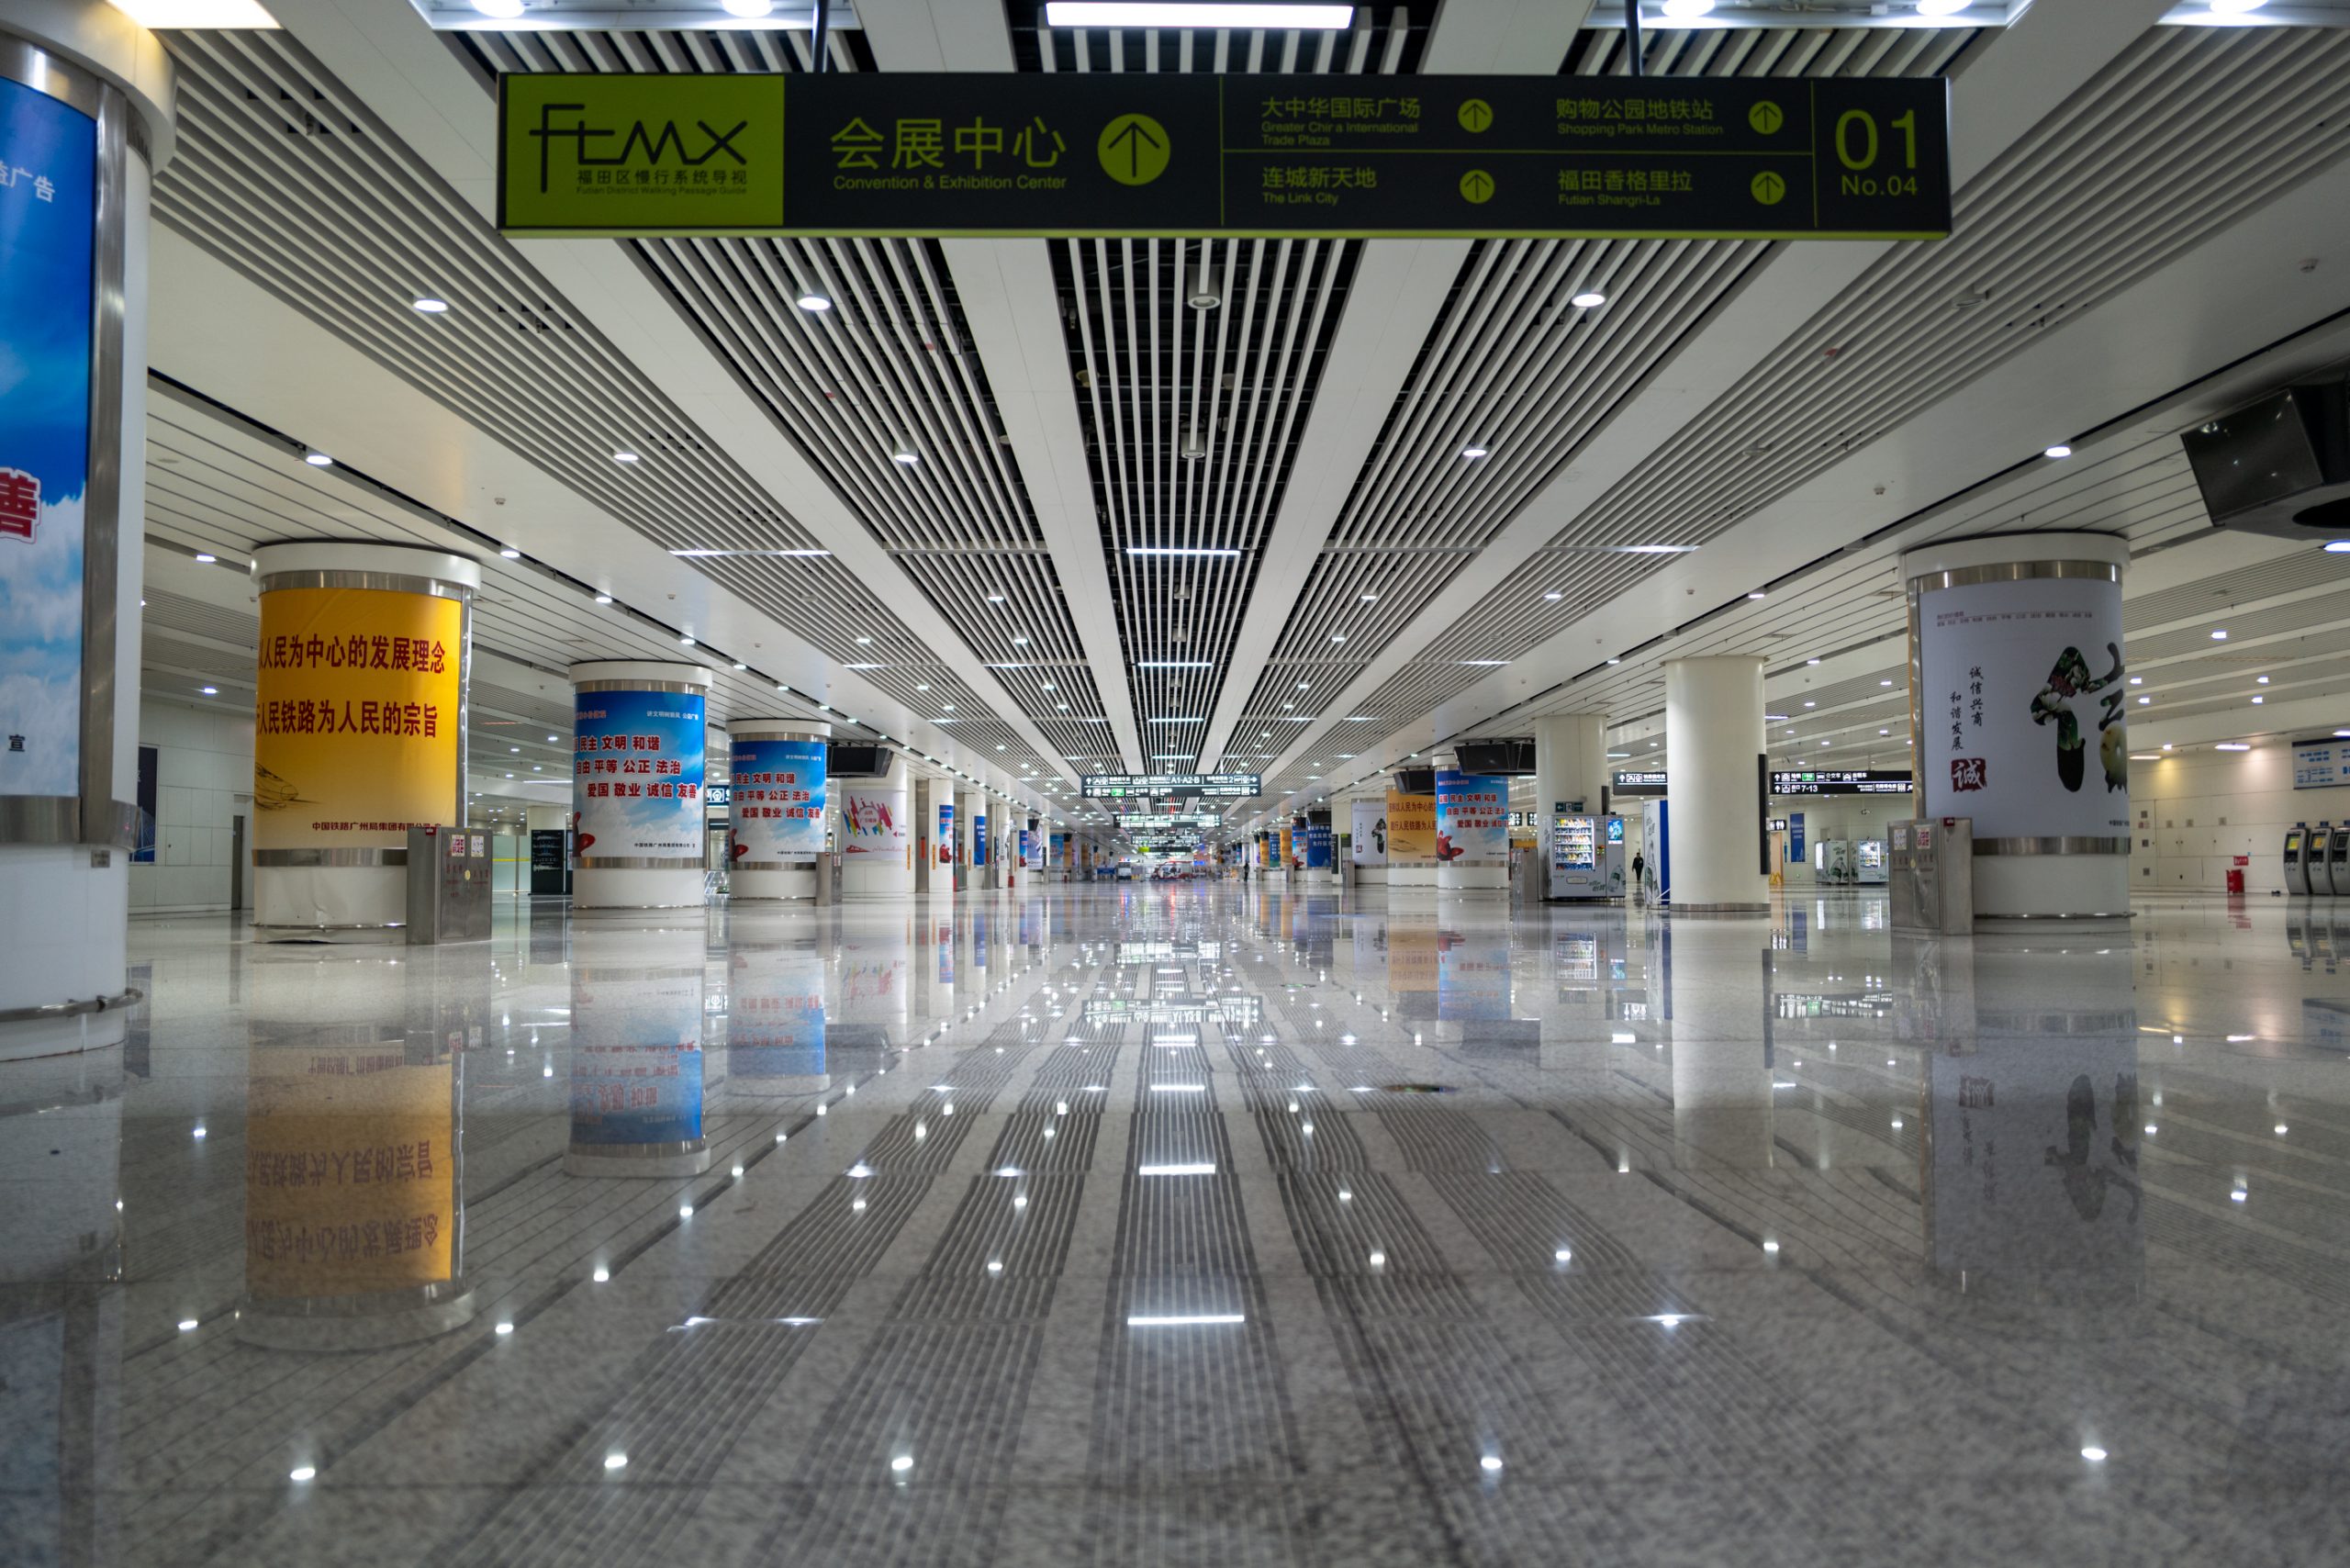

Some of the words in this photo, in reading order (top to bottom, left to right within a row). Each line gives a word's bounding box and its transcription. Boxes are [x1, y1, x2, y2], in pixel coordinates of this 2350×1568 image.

[1261, 96, 1421, 119] 大中华国际广场
[1556, 98, 1714, 120] 购物公园地铁站
[1261, 121, 1305, 133] Greater
[1346, 121, 1419, 133] International
[1557, 122, 1615, 137] Shopping
[1617, 123, 1643, 135] Park
[1646, 123, 1679, 135] Metro
[1682, 123, 1723, 136] Station
[830, 116, 1067, 170] 会展中心
[1262, 134, 1295, 146] Trade
[1298, 134, 1330, 146] Plaza
[1835, 108, 1916, 170] 01
[576, 169, 748, 185] 福田区慢行系统导视
[833, 175, 919, 190] Convention
[923, 175, 934, 189] &
[939, 175, 1013, 190] Exhibition
[1016, 175, 1067, 190] Center
[1262, 166, 1378, 189] 连城新天地
[1558, 169, 1694, 192] 福田香格里拉
[1841, 174, 1918, 196] No.04
[576, 186, 604, 196] Futian
[607, 186, 639, 196] District
[641, 186, 677, 196] Walking
[679, 186, 718, 196] Passage
[720, 186, 747, 196] Guide
[1263, 193, 1285, 204] The
[1288, 193, 1312, 204] Link
[1315, 193, 1339, 206] City
[1559, 195, 1595, 206] Futian
[1949, 690, 1964, 752] 和谐发展
[580, 735, 597, 751] 民主
[601, 734, 627, 750] 文明
[632, 735, 660, 751] 和谐
[576, 760, 591, 775] 自由
[594, 759, 618, 774] 平等
[623, 759, 651, 775] 公正
[655, 760, 681, 776] 法治
[736, 772, 750, 785] 民主
[752, 773, 771, 785] 文明
[776, 773, 795, 785] 和谐
[588, 783, 610, 798] 爱国
[614, 782, 641, 798] 敬业
[646, 783, 673, 798] 诚信
[677, 784, 697, 799] 友善
[747, 790, 765, 801] 平等
[769, 790, 789, 801] 公正
[792, 790, 810, 801] 法治
